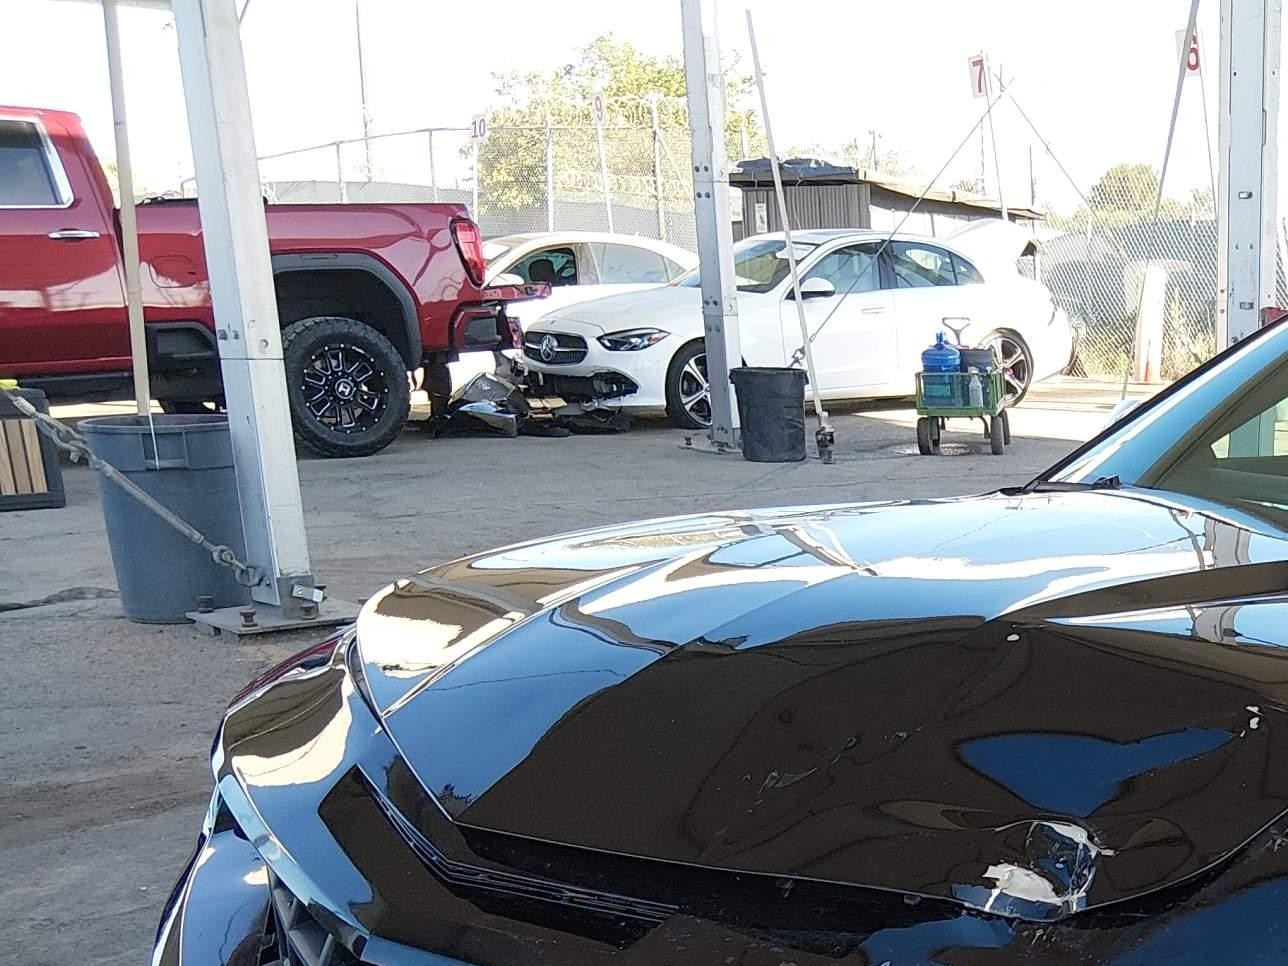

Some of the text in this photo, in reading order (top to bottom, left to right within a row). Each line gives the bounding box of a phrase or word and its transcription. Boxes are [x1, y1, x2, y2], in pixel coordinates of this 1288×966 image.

[1186, 34, 1200, 71] 6
[972, 59, 984, 93] 7
[594, 95, 603, 122] 9
[471, 118, 486, 138] 10
